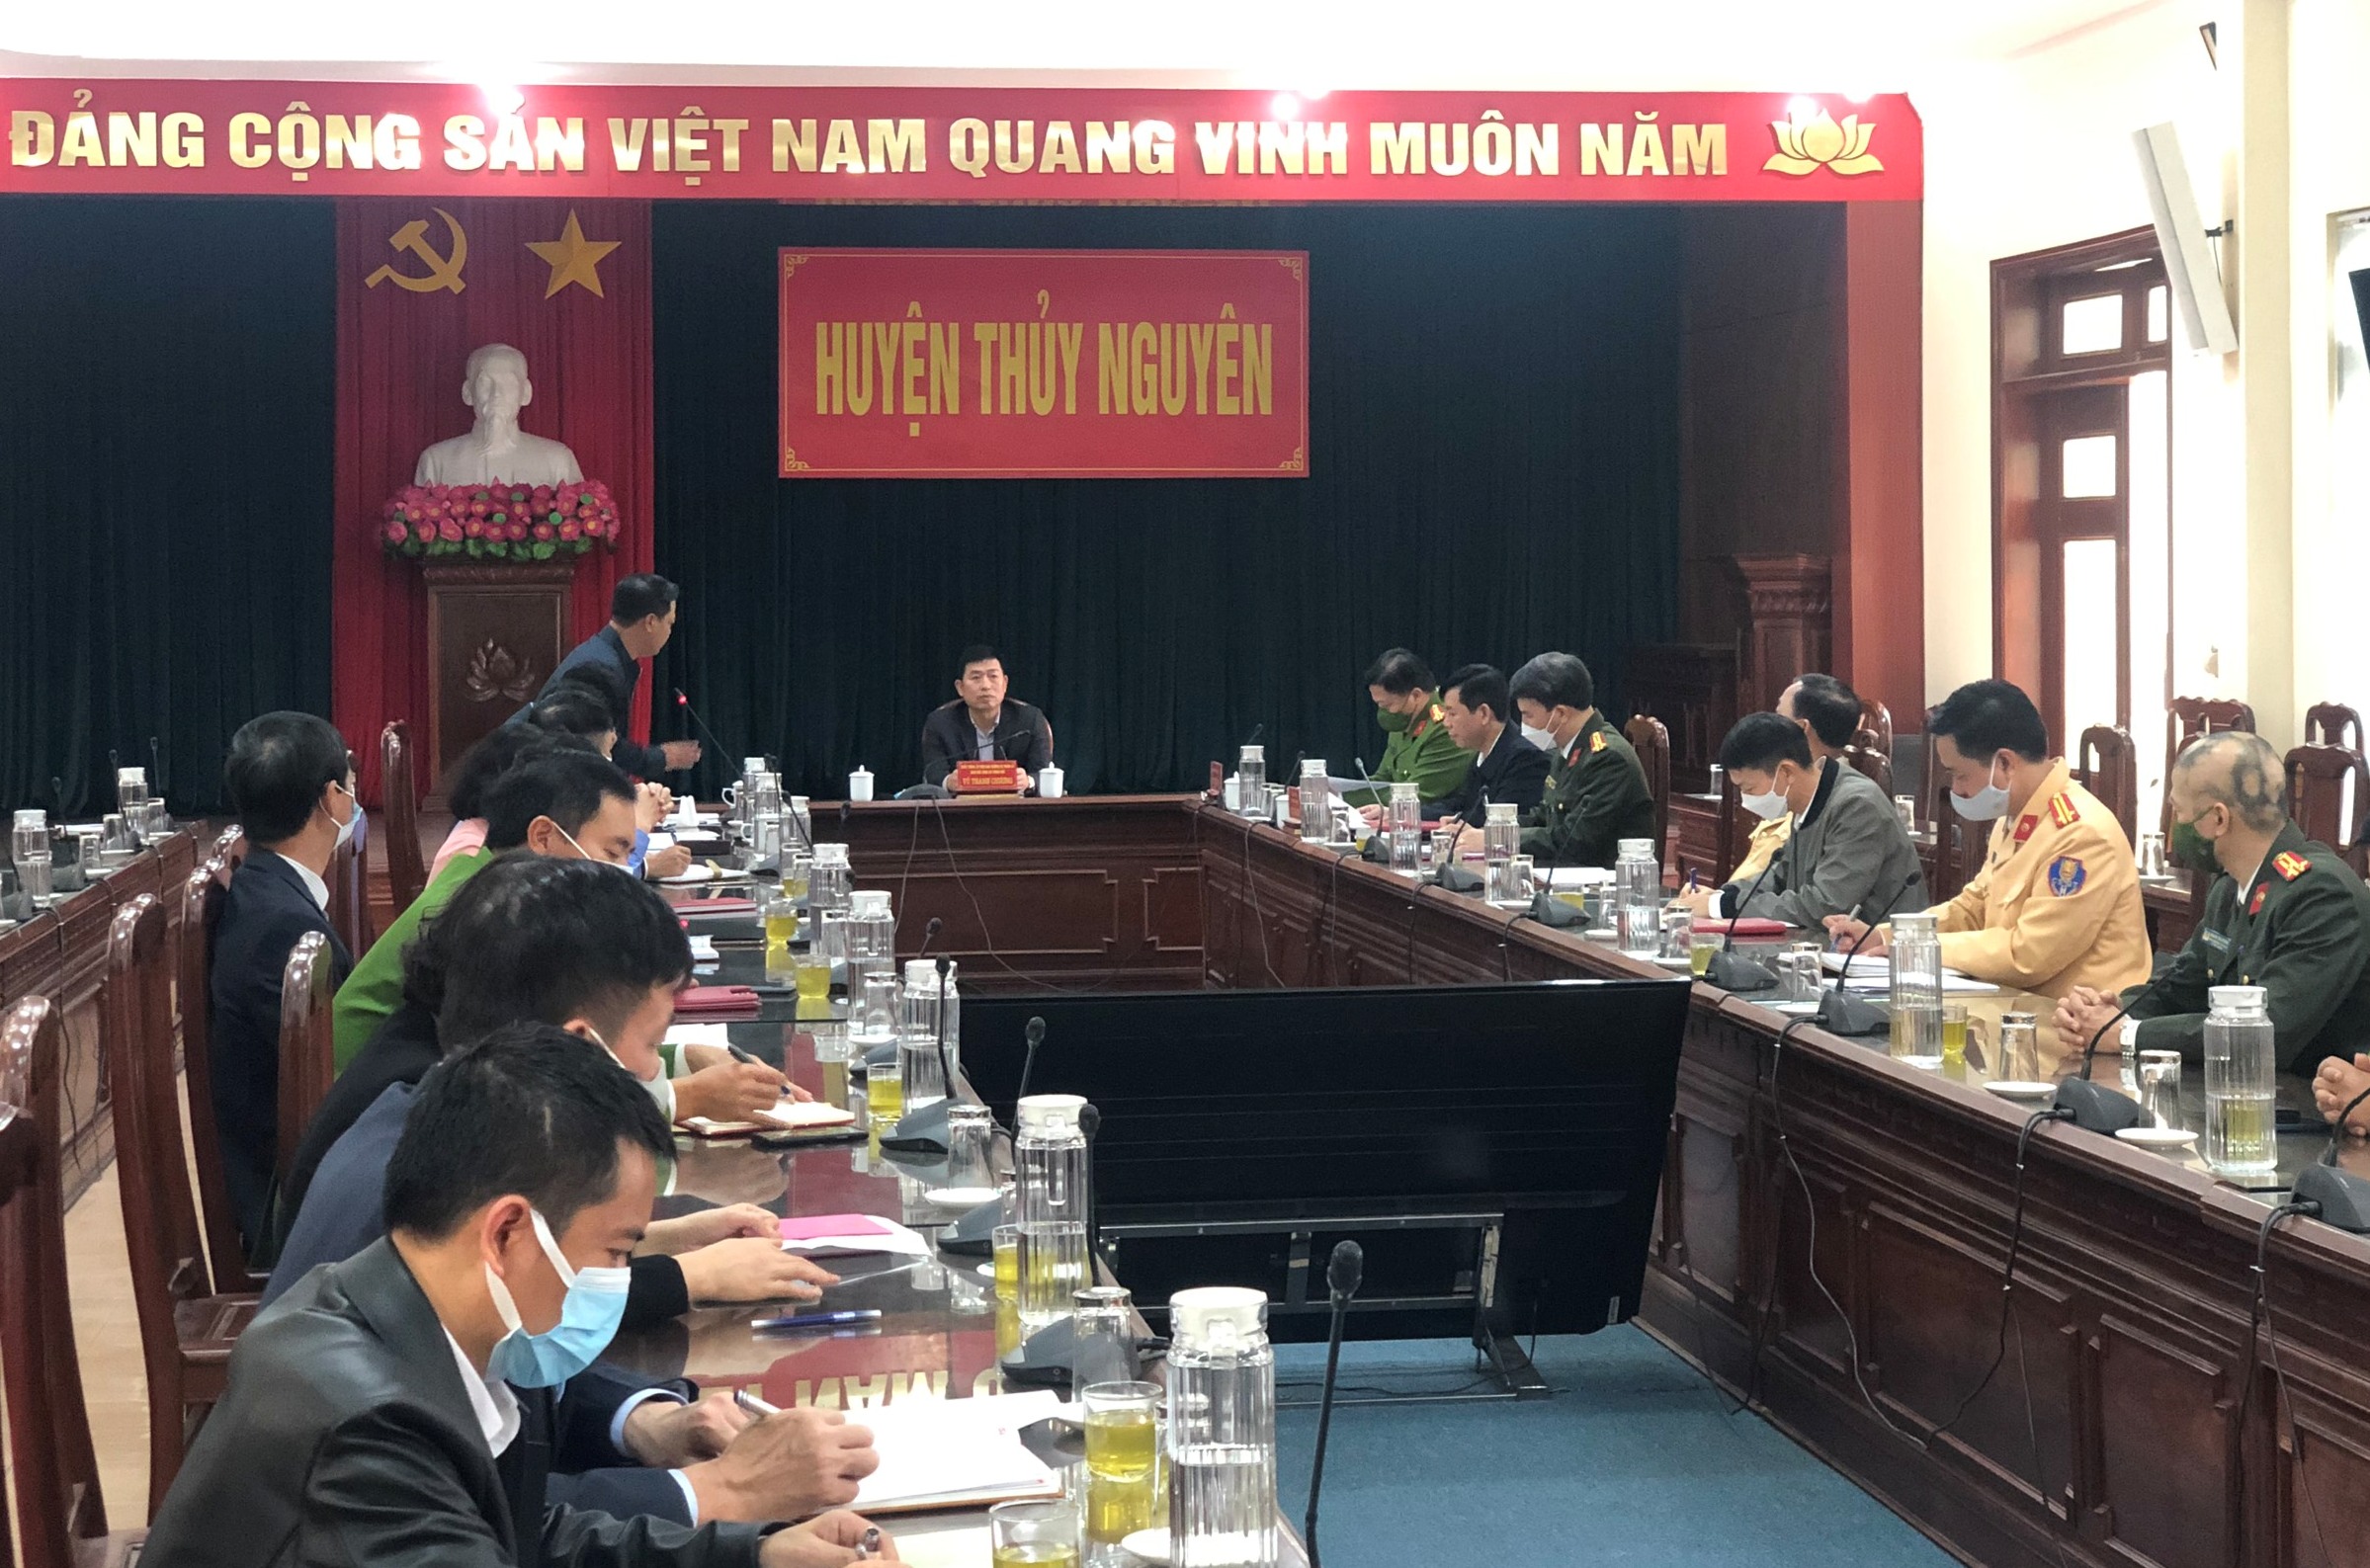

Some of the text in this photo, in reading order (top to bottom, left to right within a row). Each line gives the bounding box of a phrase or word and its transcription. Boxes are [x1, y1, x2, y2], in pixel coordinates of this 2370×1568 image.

[9, 88, 206, 168] ĐẢNG
[228, 101, 422, 182] CỘNG
[607, 106, 748, 186] VIỆT
[772, 119, 926, 173] NAM
[949, 118, 1176, 179] QUANG
[1195, 120, 1349, 175] VINH
[1369, 110, 1560, 178] MUÔN
[1580, 111, 1728, 176] NĂM
[817, 289, 1272, 437] HUYỆN THỦY NGUYÊN
